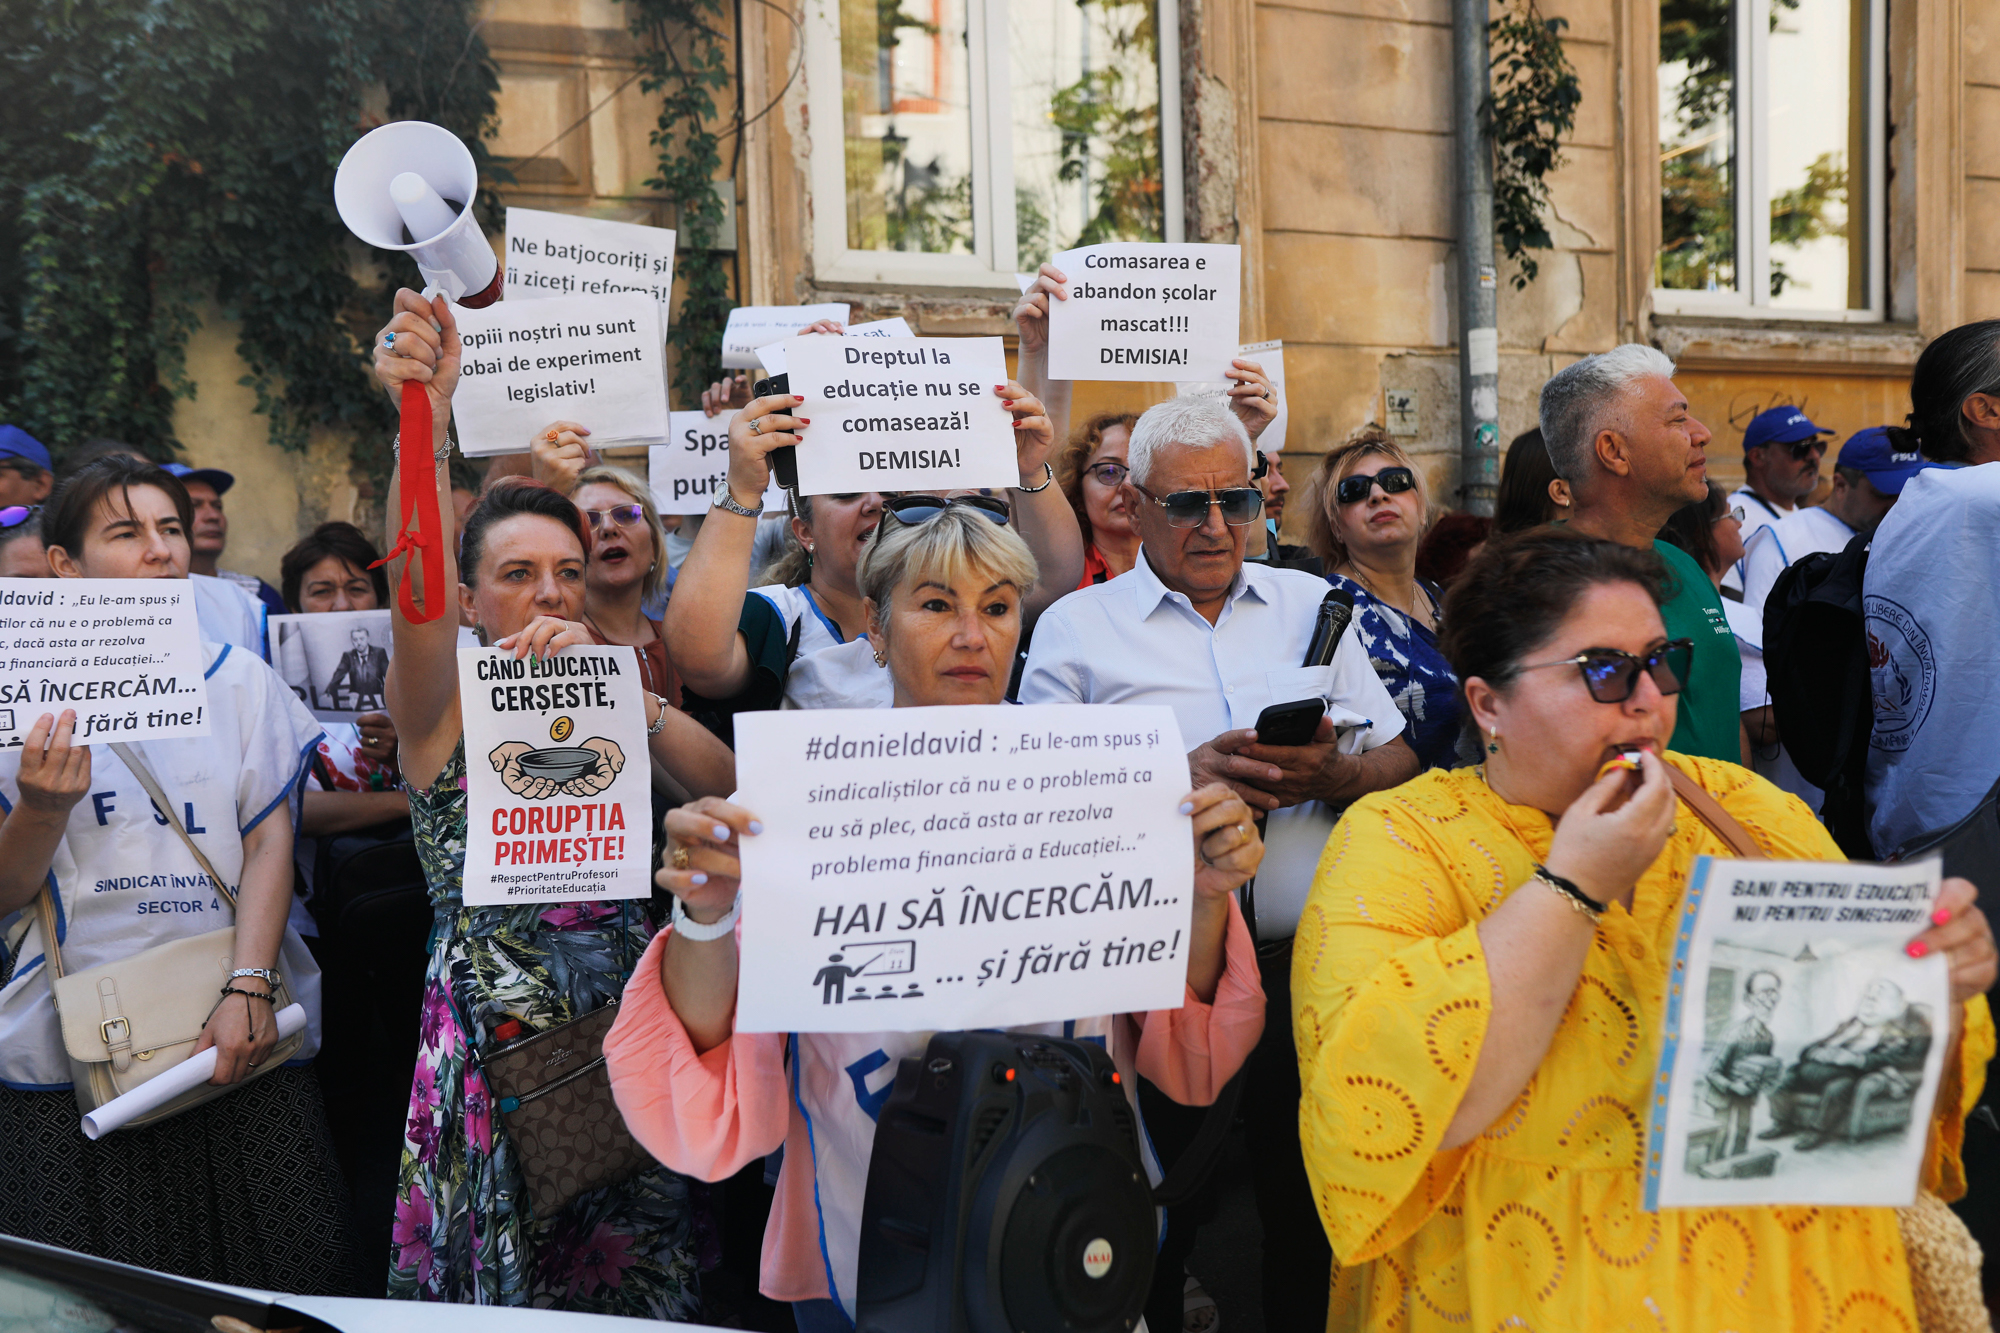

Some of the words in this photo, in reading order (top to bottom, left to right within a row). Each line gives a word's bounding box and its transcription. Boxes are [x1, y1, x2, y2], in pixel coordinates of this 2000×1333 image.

[512, 237, 538, 255] Ne
[545, 239, 647, 272] batjocoriți
[653, 256, 667, 275] și
[1085, 254, 1189, 269] Comasarea
[1196, 258, 1206, 270] e
[507, 267, 518, 285] îi
[524, 270, 575, 294] ziceți
[1073, 282, 1156, 299] abandon
[1162, 284, 1217, 304] școlar
[458, 328, 503, 349] opiii
[509, 323, 562, 344] noștri
[568, 325, 590, 337] nu
[596, 319, 636, 335] sunt
[1101, 316, 1188, 332] mascat!!!
[459, 357, 502, 377] obai
[508, 356, 530, 372] de
[536, 347, 642, 371] experiment
[845, 347, 926, 369] Dreptul
[932, 348, 951, 364] la
[1101, 348, 1187, 365] DEMISIA!
[507, 378, 595, 403] legislativ!
[823, 379, 918, 401] educație
[925, 383, 952, 396] nu
[958, 383, 980, 396] se
[842, 411, 969, 433] comasează!
[859, 448, 960, 470] DEMISIA!
[99, 594, 136, 605] le-am
[140, 597, 167, 606] spus
[170, 594, 180, 606] și
[30, 618, 44, 628] că
[49, 620, 65, 628] nu
[69, 620, 77, 628] e
[81, 620, 89, 628] o
[92, 616, 155, 629] problemă
[13, 638, 45, 648] dacă
[49, 638, 77, 648] asta
[81, 639, 95, 647] ar
[99, 635, 145, 646] rezolva
[9, 657, 77, 671] financiară
[81, 659, 89, 667] a
[477, 655, 525, 680] CÂND
[0, 679, 31, 704] SĂ
[40, 674, 196, 702] ÎNCERCĂM...
[491, 682, 615, 716] CERȘESTE,
[83, 711, 138, 737] fără
[147, 706, 202, 728] tine!
[806, 728, 982, 761] #danieldavid
[1010, 733, 1041, 754] „Eu
[1048, 732, 1098, 749] le-am
[1104, 733, 1141, 750] spus
[1147, 729, 1159, 749] și
[808, 779, 943, 803] sindicaliștilor
[949, 776, 970, 794] că
[977, 779, 1000, 792] nu
[1007, 778, 1017, 791] e
[1023, 777, 1034, 790] o
[1040, 767, 1127, 793] problemă
[1133, 770, 1152, 783] ca
[492, 803, 625, 837] CORUPȚIA
[809, 826, 833, 839] eu
[841, 819, 863, 837] să
[869, 817, 915, 840] plec,
[923, 812, 970, 832] dacă
[977, 812, 1017, 828] asta
[1024, 812, 1043, 825] ar
[1049, 804, 1113, 823] rezolva
[495, 836, 624, 867] PRIMEȘTE!
[811, 855, 910, 880] problema
[916, 845, 1016, 873] financiară
[1022, 848, 1033, 860] a
[94, 875, 167, 893] SINDICAT
[490, 869, 618, 884] #RespectPentruProfesori
[507, 882, 606, 895] #PrioritateEducația
[1781, 881, 1851, 899] PENTRU
[137, 900, 203, 914] SECTOR
[211, 898, 219, 911] 4
[813, 902, 886, 937] HAI
[897, 887, 945, 930] SĂ
[959, 872, 1178, 925] ÎNCERCĂM...
[1734, 906, 1760, 921] NU
[1763, 906, 1833, 922] PENTRU
[977, 949, 1009, 987] și
[1011, 940, 1091, 984] fără
[1102, 929, 1181, 967] tine!
